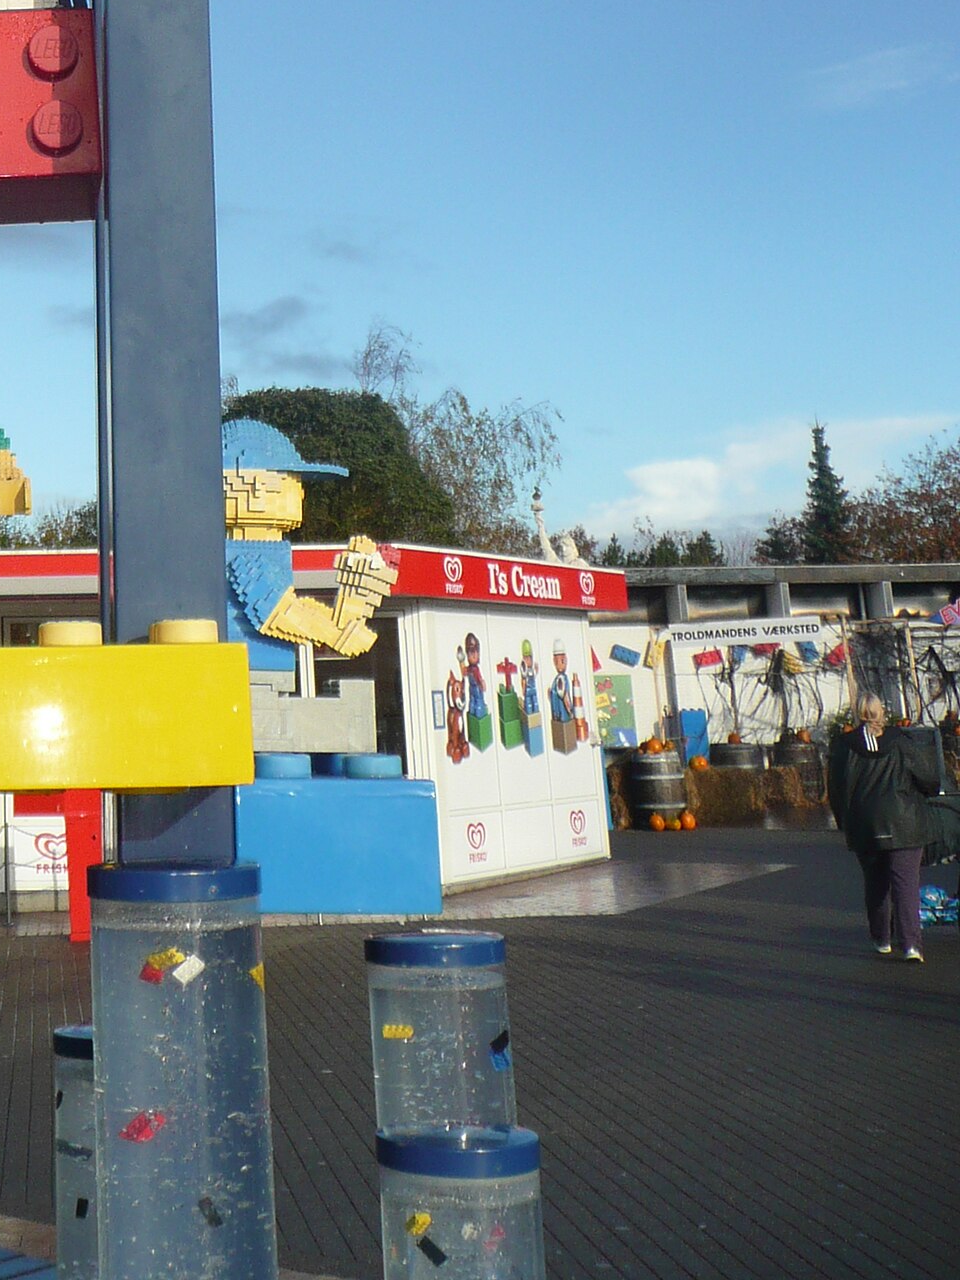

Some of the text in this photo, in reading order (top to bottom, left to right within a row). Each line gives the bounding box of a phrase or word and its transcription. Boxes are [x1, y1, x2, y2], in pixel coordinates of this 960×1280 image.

[487, 563, 562, 600] I's Cream
[671, 623, 820, 642] TROLDMANDENS VÆRKSTED
